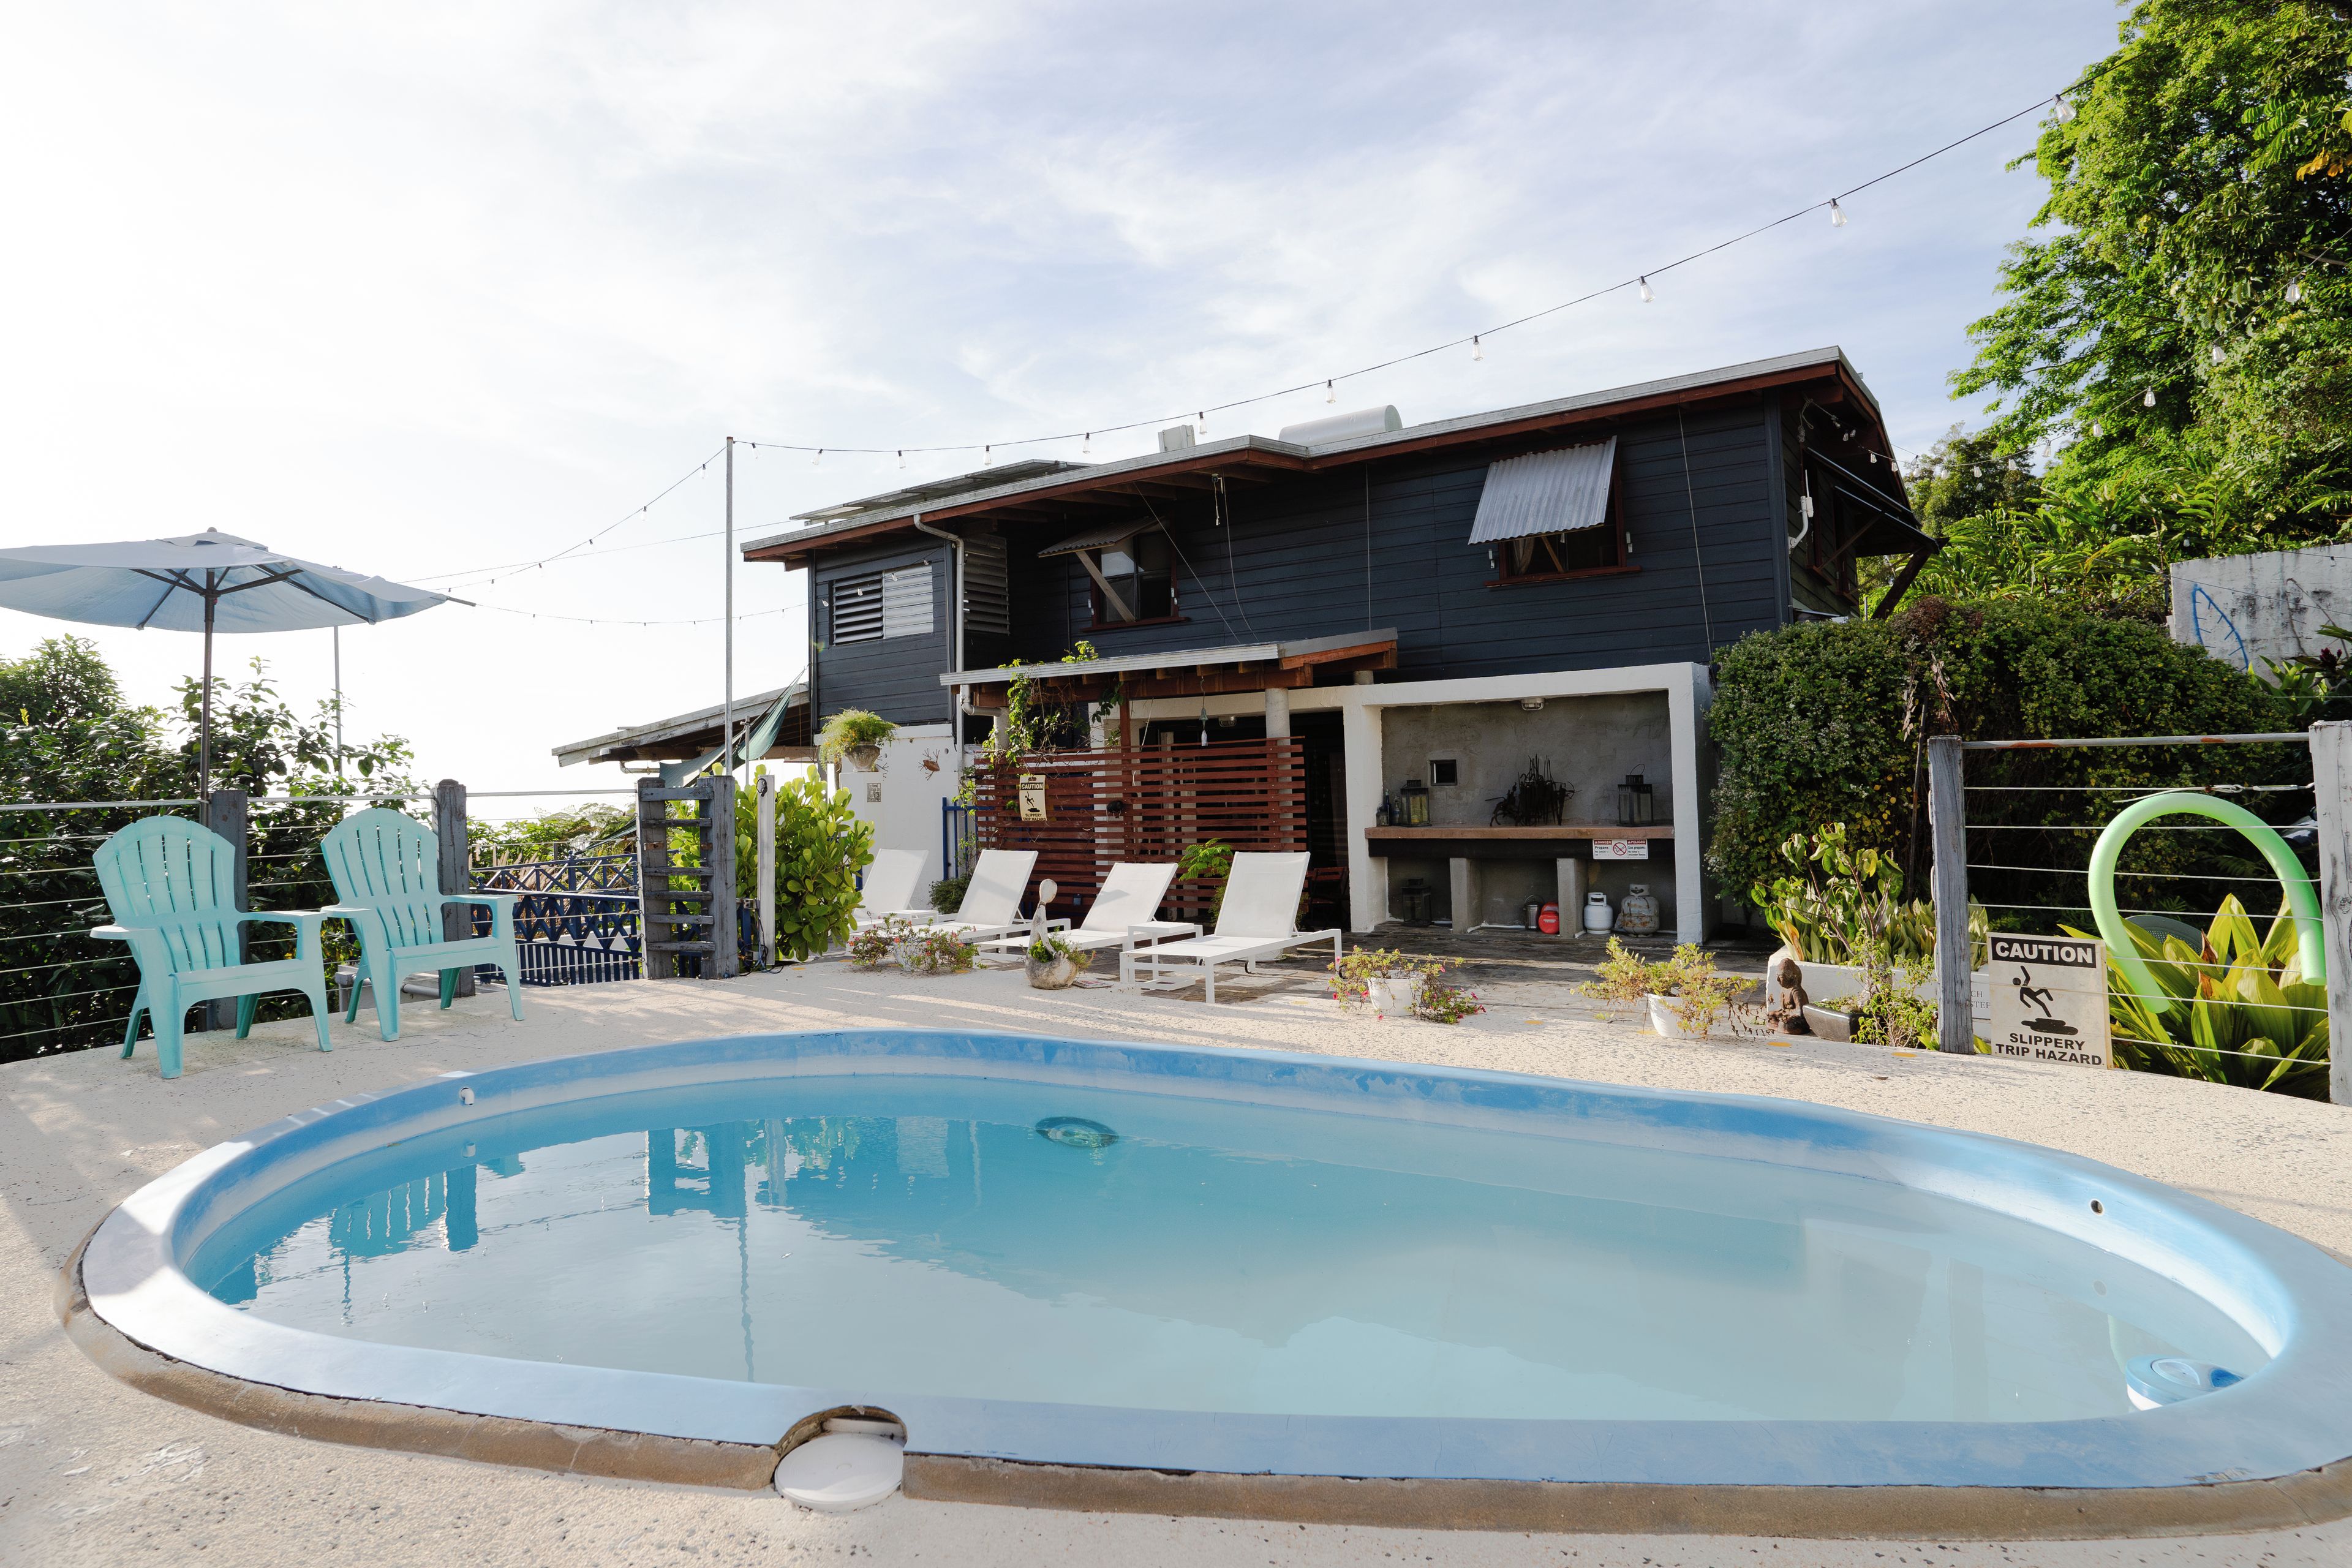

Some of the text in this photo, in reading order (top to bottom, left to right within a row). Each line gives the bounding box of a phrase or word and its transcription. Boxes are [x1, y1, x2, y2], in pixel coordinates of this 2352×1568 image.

[1996, 941, 2093, 963] CAUTION
[2010, 1033, 2086, 1050] SLIPPERY
[1996, 1043, 2102, 1065] TRIP HAZARD
